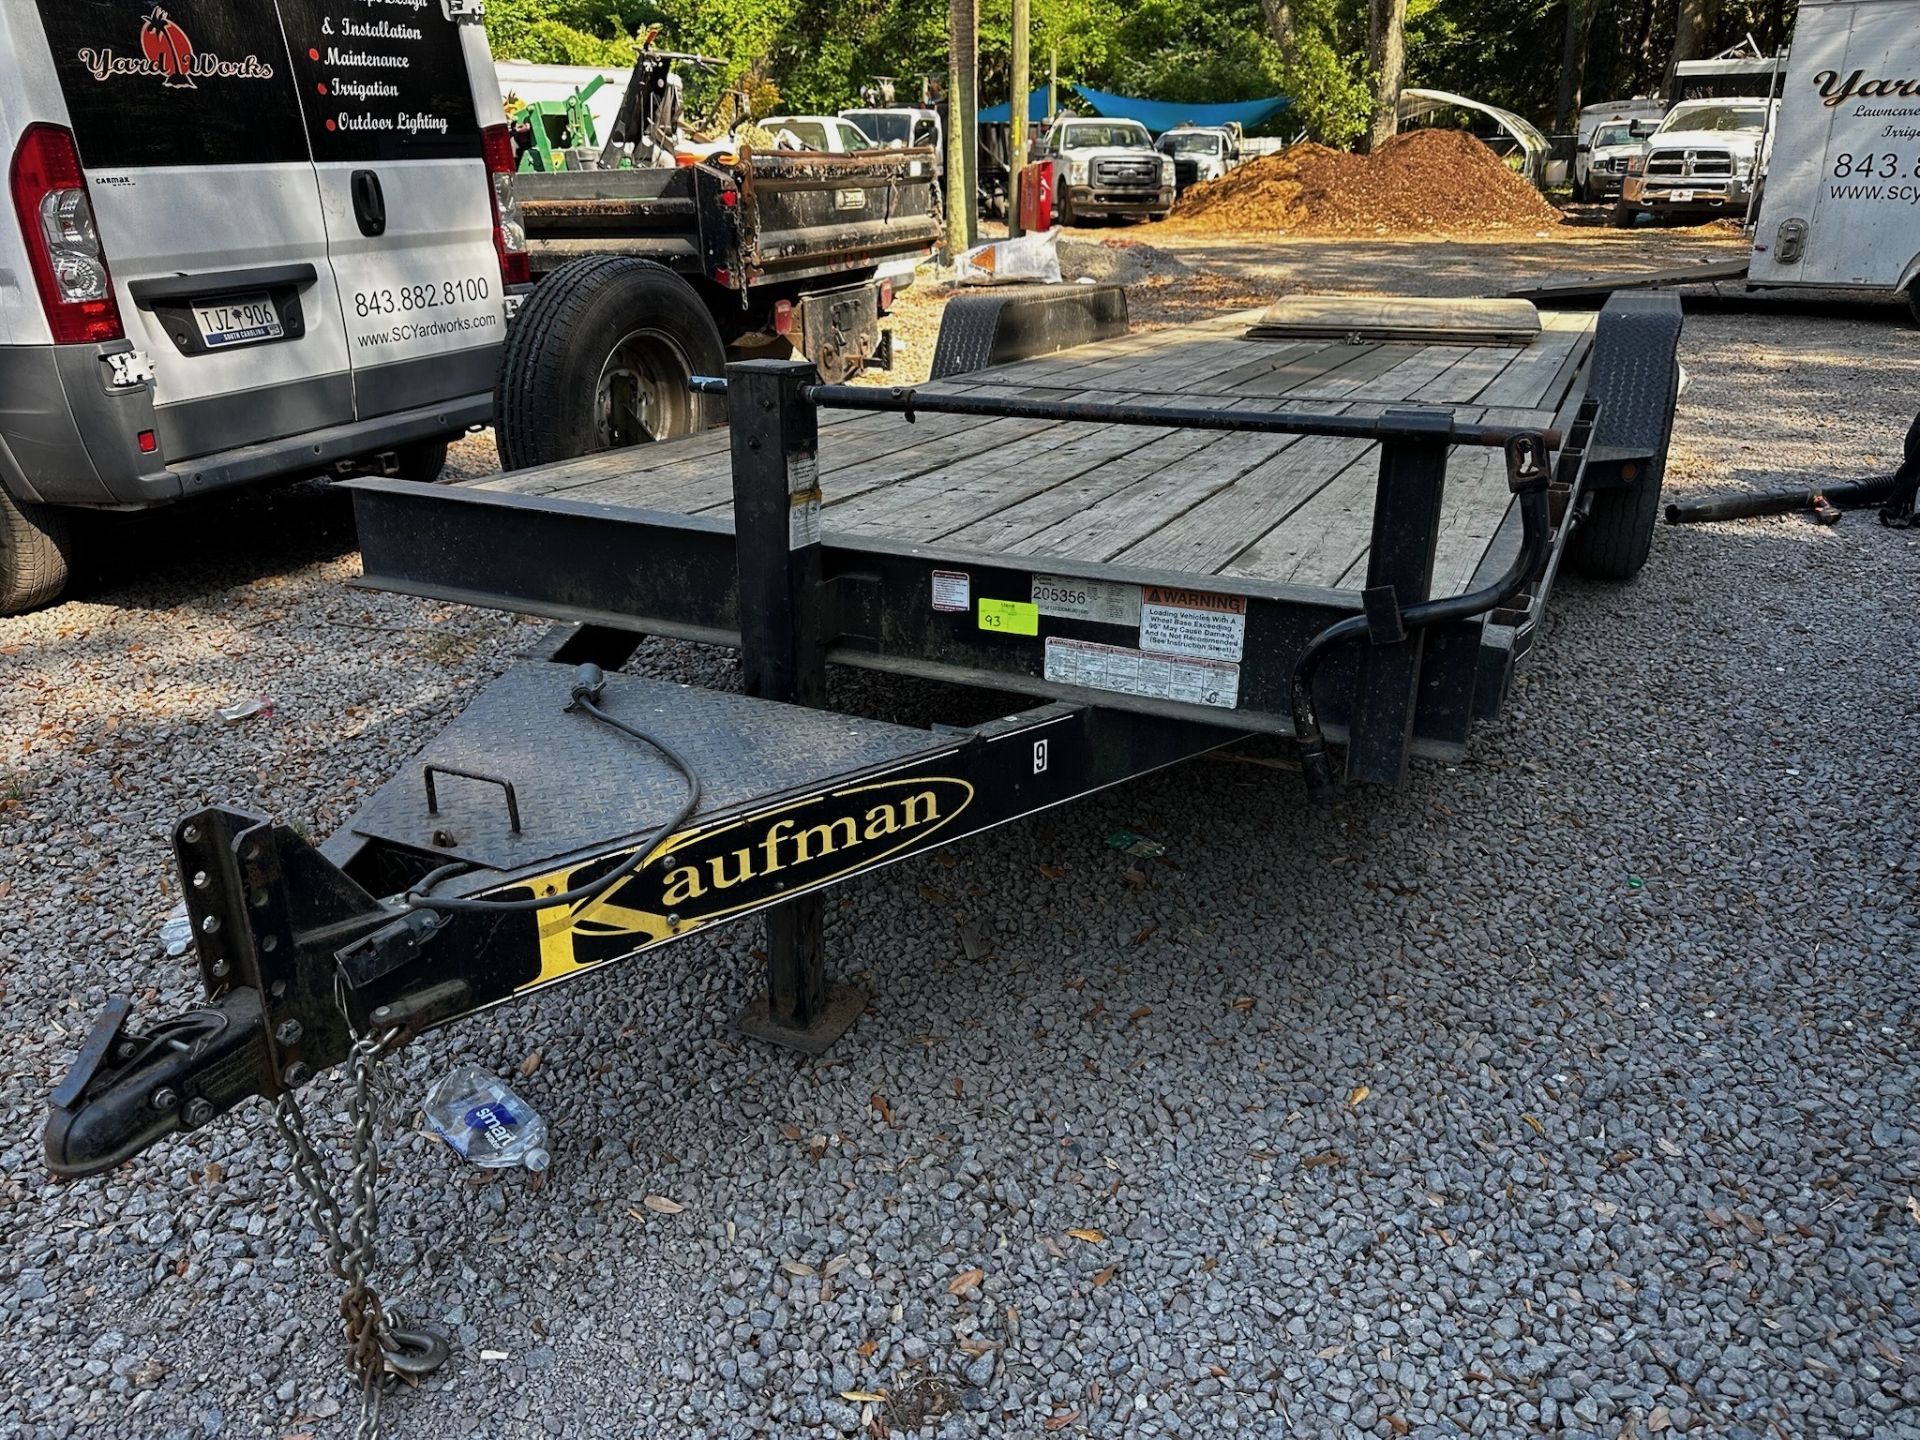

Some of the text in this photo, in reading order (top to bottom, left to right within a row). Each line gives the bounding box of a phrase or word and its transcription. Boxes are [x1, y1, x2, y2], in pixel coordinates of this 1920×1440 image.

[321, 16, 422, 40] & Installation
[77, 48, 274, 81] Yard Works
[324, 46, 410, 68] Maintenance
[331, 77, 400, 102] Irrigation
[1813, 69, 1920, 107] Yar
[1852, 105, 1920, 117] Lawncare
[338, 111, 448, 135] Outdoor Lighting
[1831, 185, 1920, 205] www.scy
[355, 277, 489, 317] 843.882.8100
[201, 304, 273, 333] TJZ 906
[223, 332, 240, 341] SOUTH
[241, 328, 265, 338] CAROLINA
[358, 314, 496, 347] www.SCYardworks.com
[1033, 586, 1086, 604] 205356
[1164, 591, 1240, 611] WARNING
[985, 615, 1001, 627] 93
[1150, 609, 1178, 619] Loading
[1180, 612, 1210, 621] Vehicles
[1212, 616, 1228, 624] With
[1150, 616, 1232, 632] Wheel Base Exceeding
[1145, 629, 1159, 637] And
[1169, 632, 1181, 640] Not
[1184, 634, 1239, 647] Recommended
[1163, 624, 1178, 633] May
[1180, 626, 1202, 635] Cause
[1204, 629, 1235, 640] Damage
[1167, 639, 1206, 650] Instruction
[1036, 742, 1046, 770] 9
[475, 1107, 517, 1146] smart
